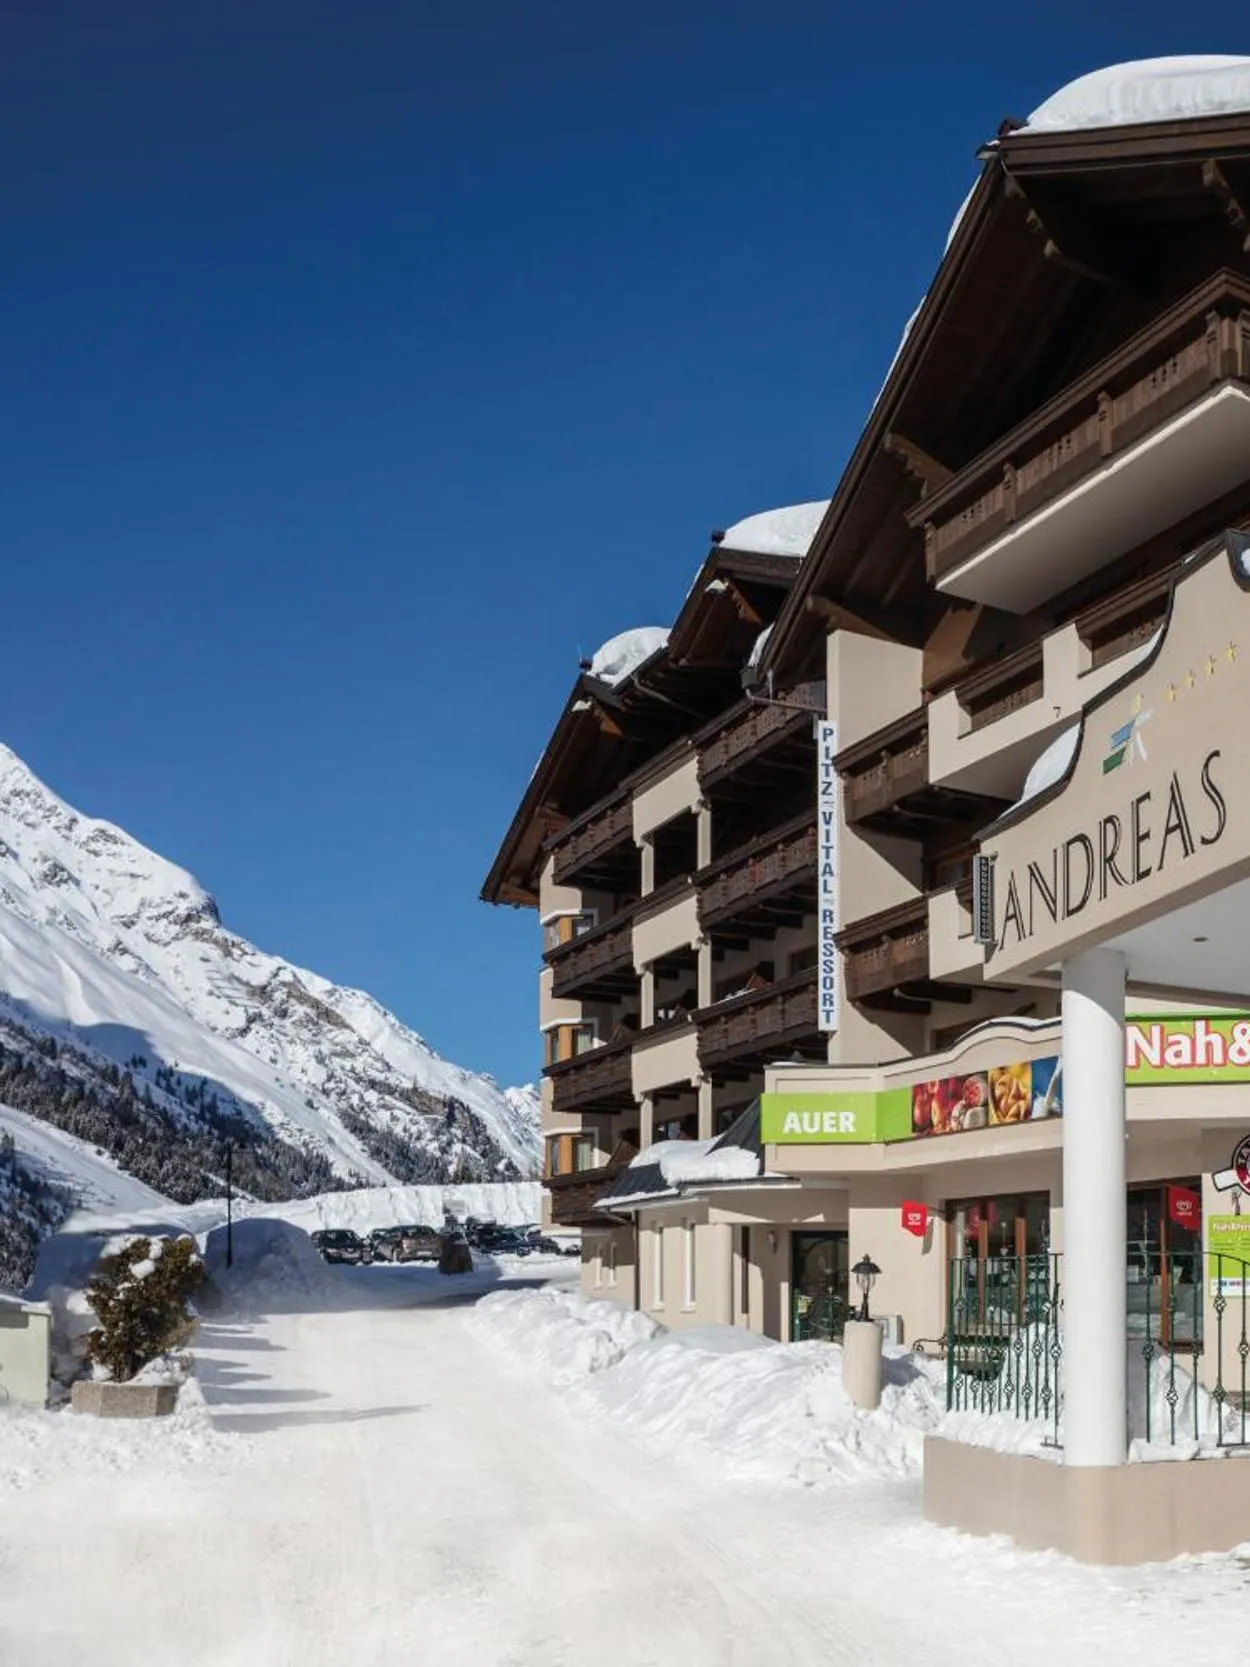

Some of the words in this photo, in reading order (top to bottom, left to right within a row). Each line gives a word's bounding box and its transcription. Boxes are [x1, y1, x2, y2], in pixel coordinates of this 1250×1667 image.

[821, 728, 834, 796] PITZ
[821, 811, 834, 894] VITAL
[998, 748, 1228, 951] ANDREAS
[822, 909, 834, 1024] RESSORT
[782, 1110, 857, 1134] AUER
